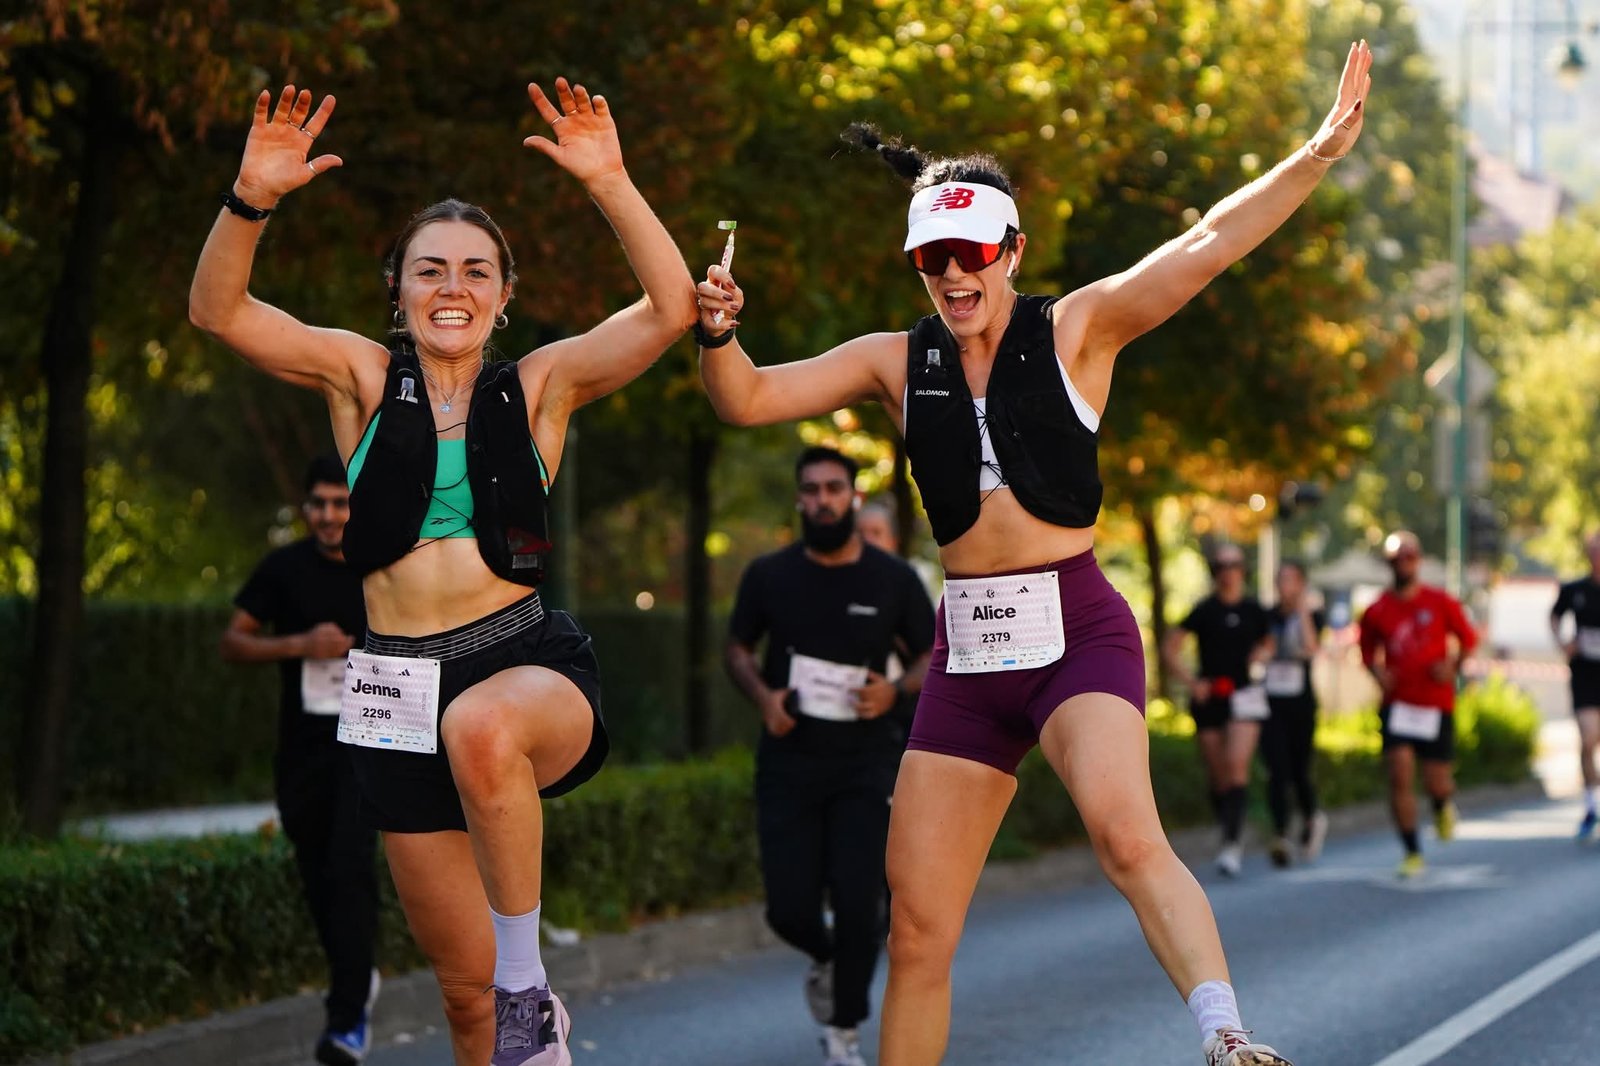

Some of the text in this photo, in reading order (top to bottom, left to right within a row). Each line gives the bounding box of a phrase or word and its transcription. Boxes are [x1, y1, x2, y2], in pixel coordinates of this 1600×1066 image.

[972, 605, 1017, 621] Alice
[981, 632, 1011, 643] 2379
[351, 678, 401, 699] Jenna
[362, 707, 392, 720] 2296
